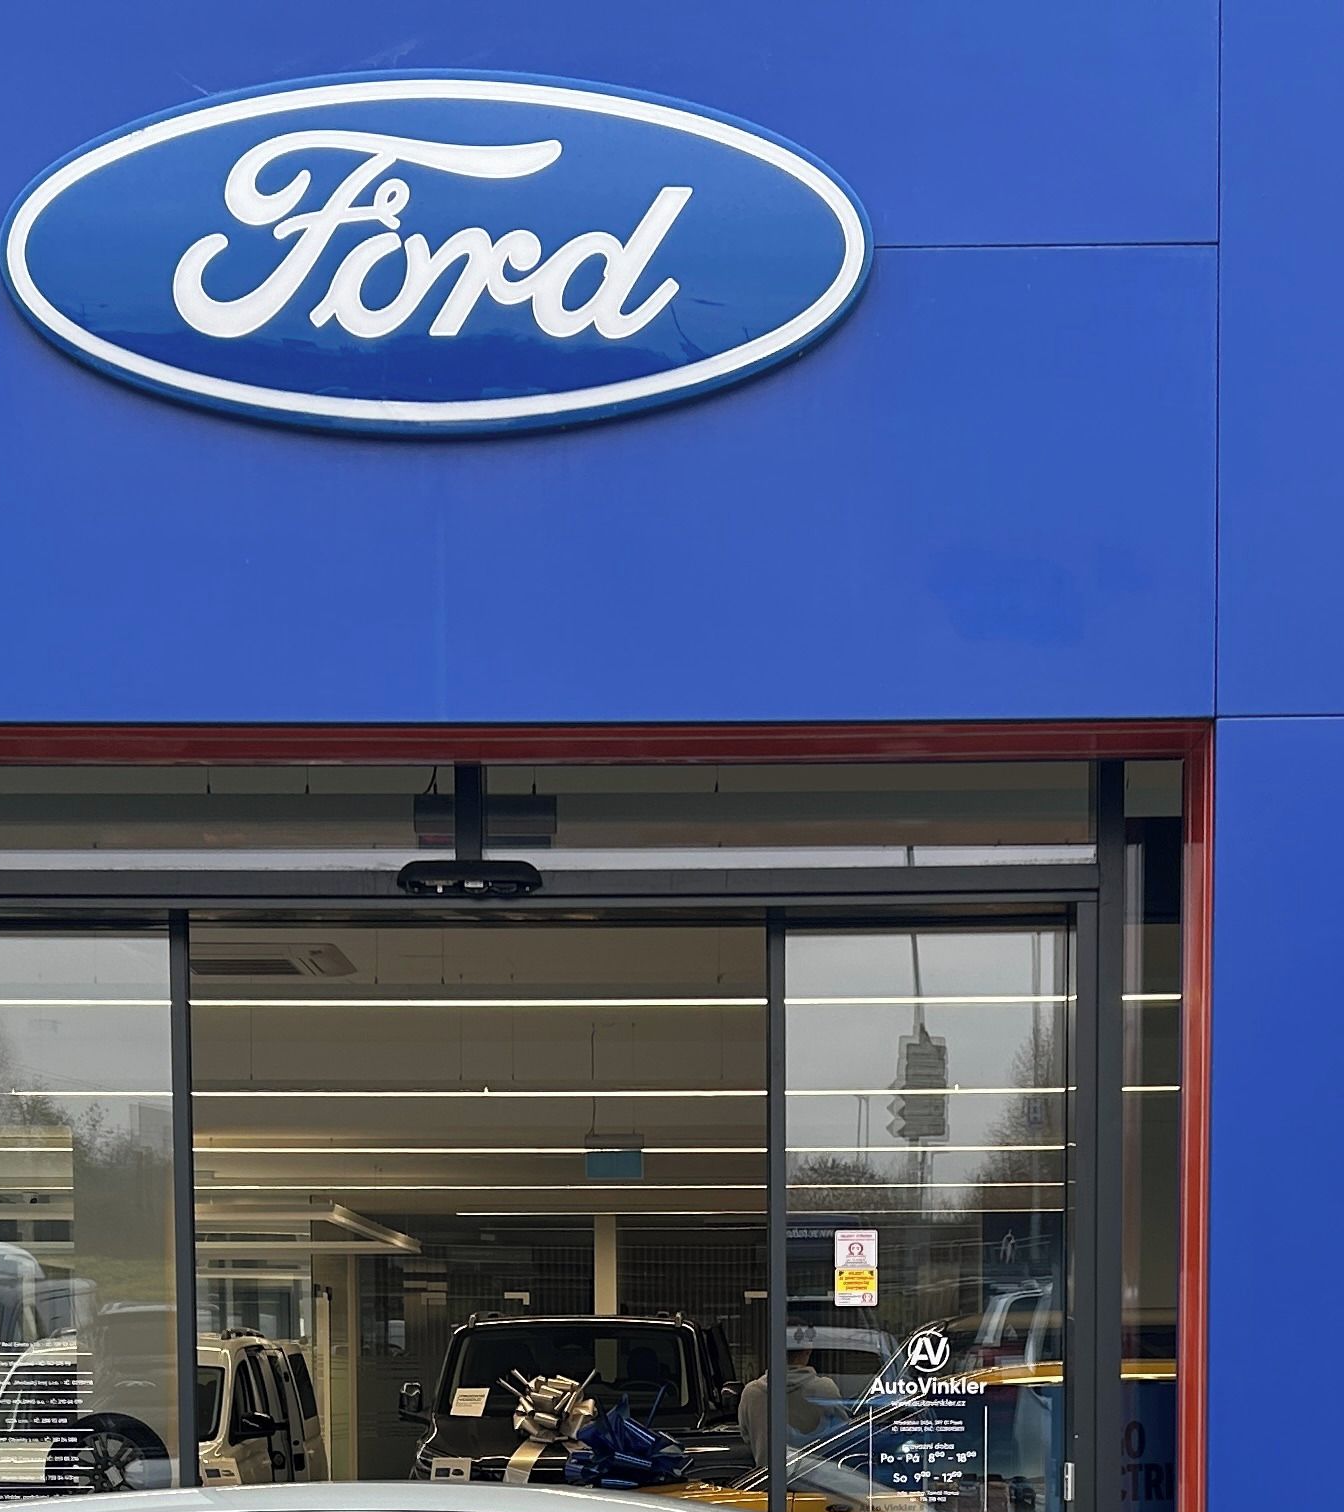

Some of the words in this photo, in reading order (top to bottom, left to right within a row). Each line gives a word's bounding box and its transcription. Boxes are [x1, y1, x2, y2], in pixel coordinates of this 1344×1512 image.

[173, 129, 693, 339] Ford
[870, 1377, 988, 1395] AutoVinkler
[880, 1453, 895, 1464] Po
[905, 1453, 920, 1463] Pá
[893, 1472, 908, 1483] So
